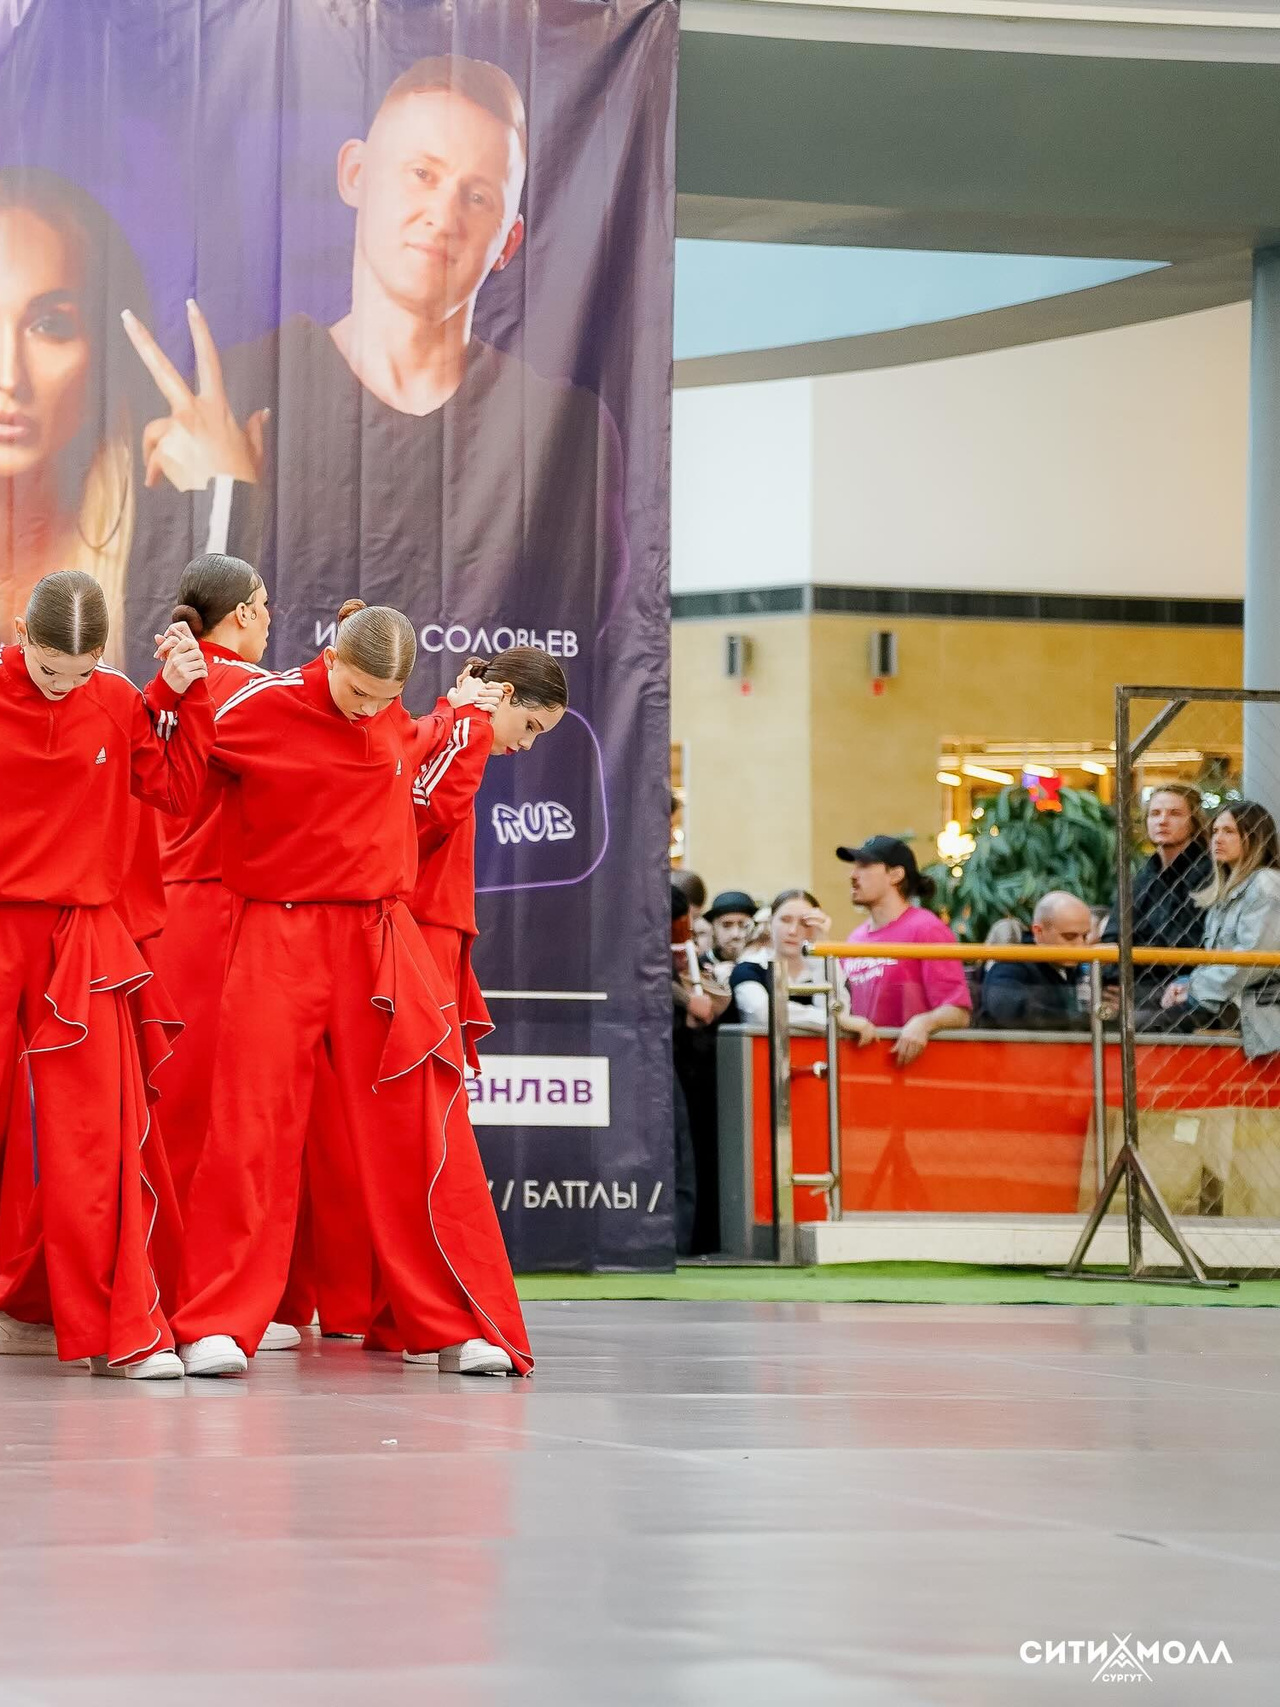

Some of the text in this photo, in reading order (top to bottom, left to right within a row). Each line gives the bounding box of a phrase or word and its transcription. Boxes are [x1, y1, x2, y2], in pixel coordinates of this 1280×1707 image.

[421, 623, 579, 657] СОЛОВЬЕВ
[491, 800, 577, 845] RUB
[464, 1076, 594, 1105] анлав
[523, 1180, 637, 1209] БАТТЛЫ
